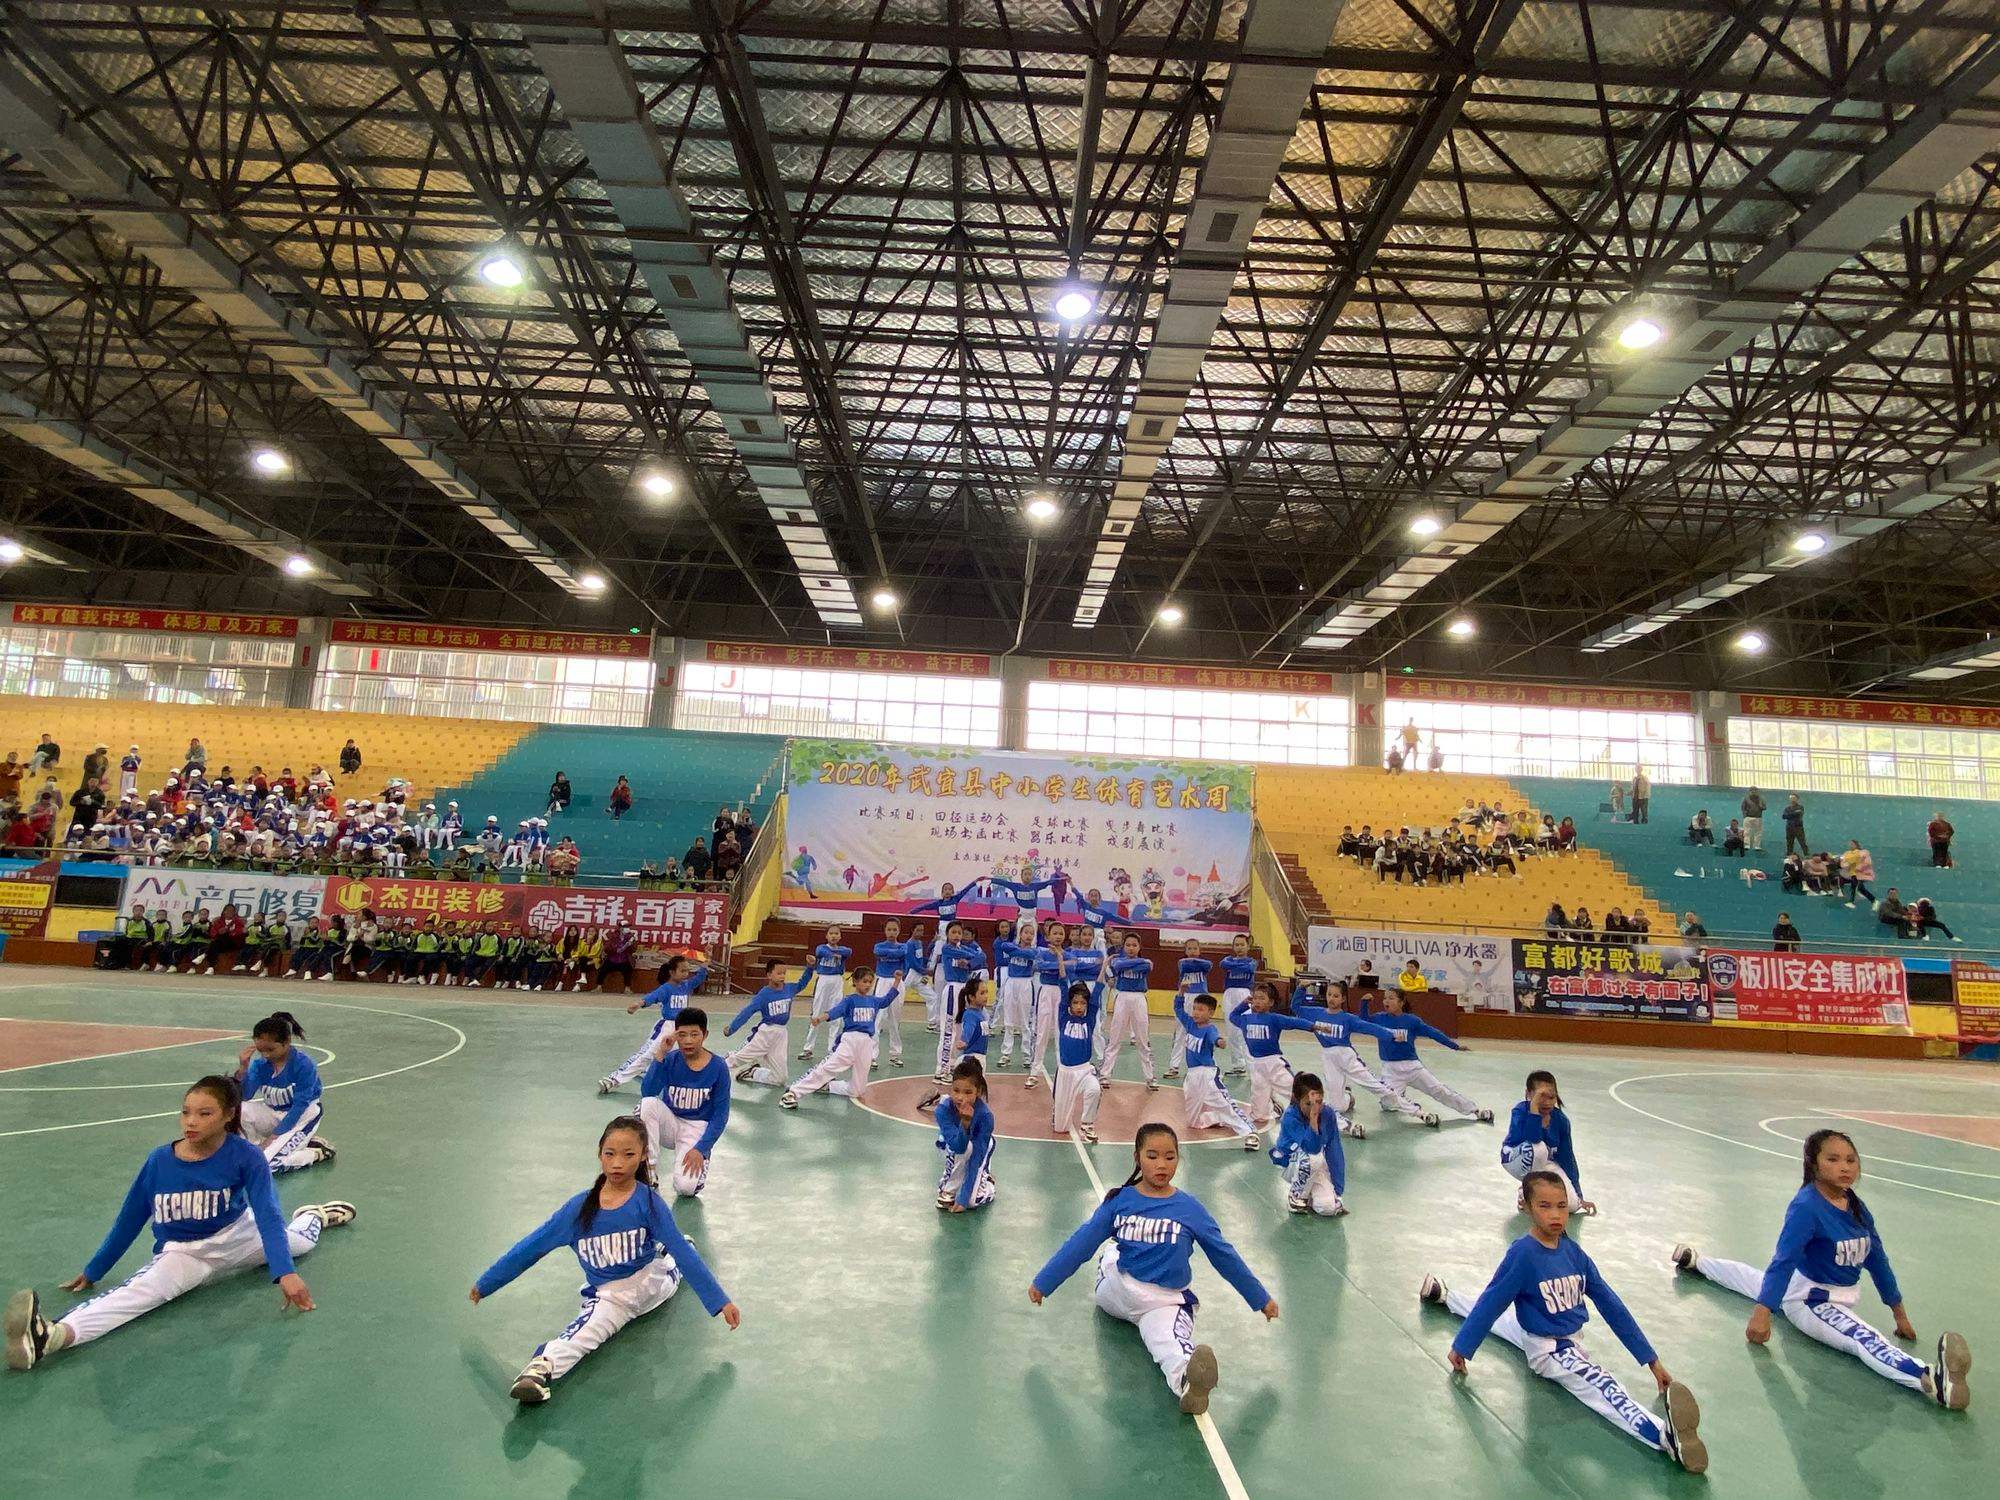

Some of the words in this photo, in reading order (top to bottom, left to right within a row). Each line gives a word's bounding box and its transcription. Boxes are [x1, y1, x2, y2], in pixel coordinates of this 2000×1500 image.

[658, 666, 675, 687] J
[1295, 700, 1311, 719] K
[1358, 704, 1376, 725] K
[1707, 722, 1726, 744] L
[818, 760, 1230, 812] 2020年武宣县中小学生体育艺术周
[194, 885, 320, 922] 产后修复
[380, 886, 506, 914] 杰出装修
[564, 895, 695, 929] 吉祥·百得
[700, 900, 724, 945] 家具馆
[1336, 936, 1367, 952] 沁园
[1371, 938, 1442, 956] TRULIVA
[1445, 941, 1498, 960] 净水器
[1521, 943, 1664, 975] 富都好歌城
[1739, 955, 1902, 995] 板川安全集成灶
[154, 1187, 231, 1224] SECURITY
